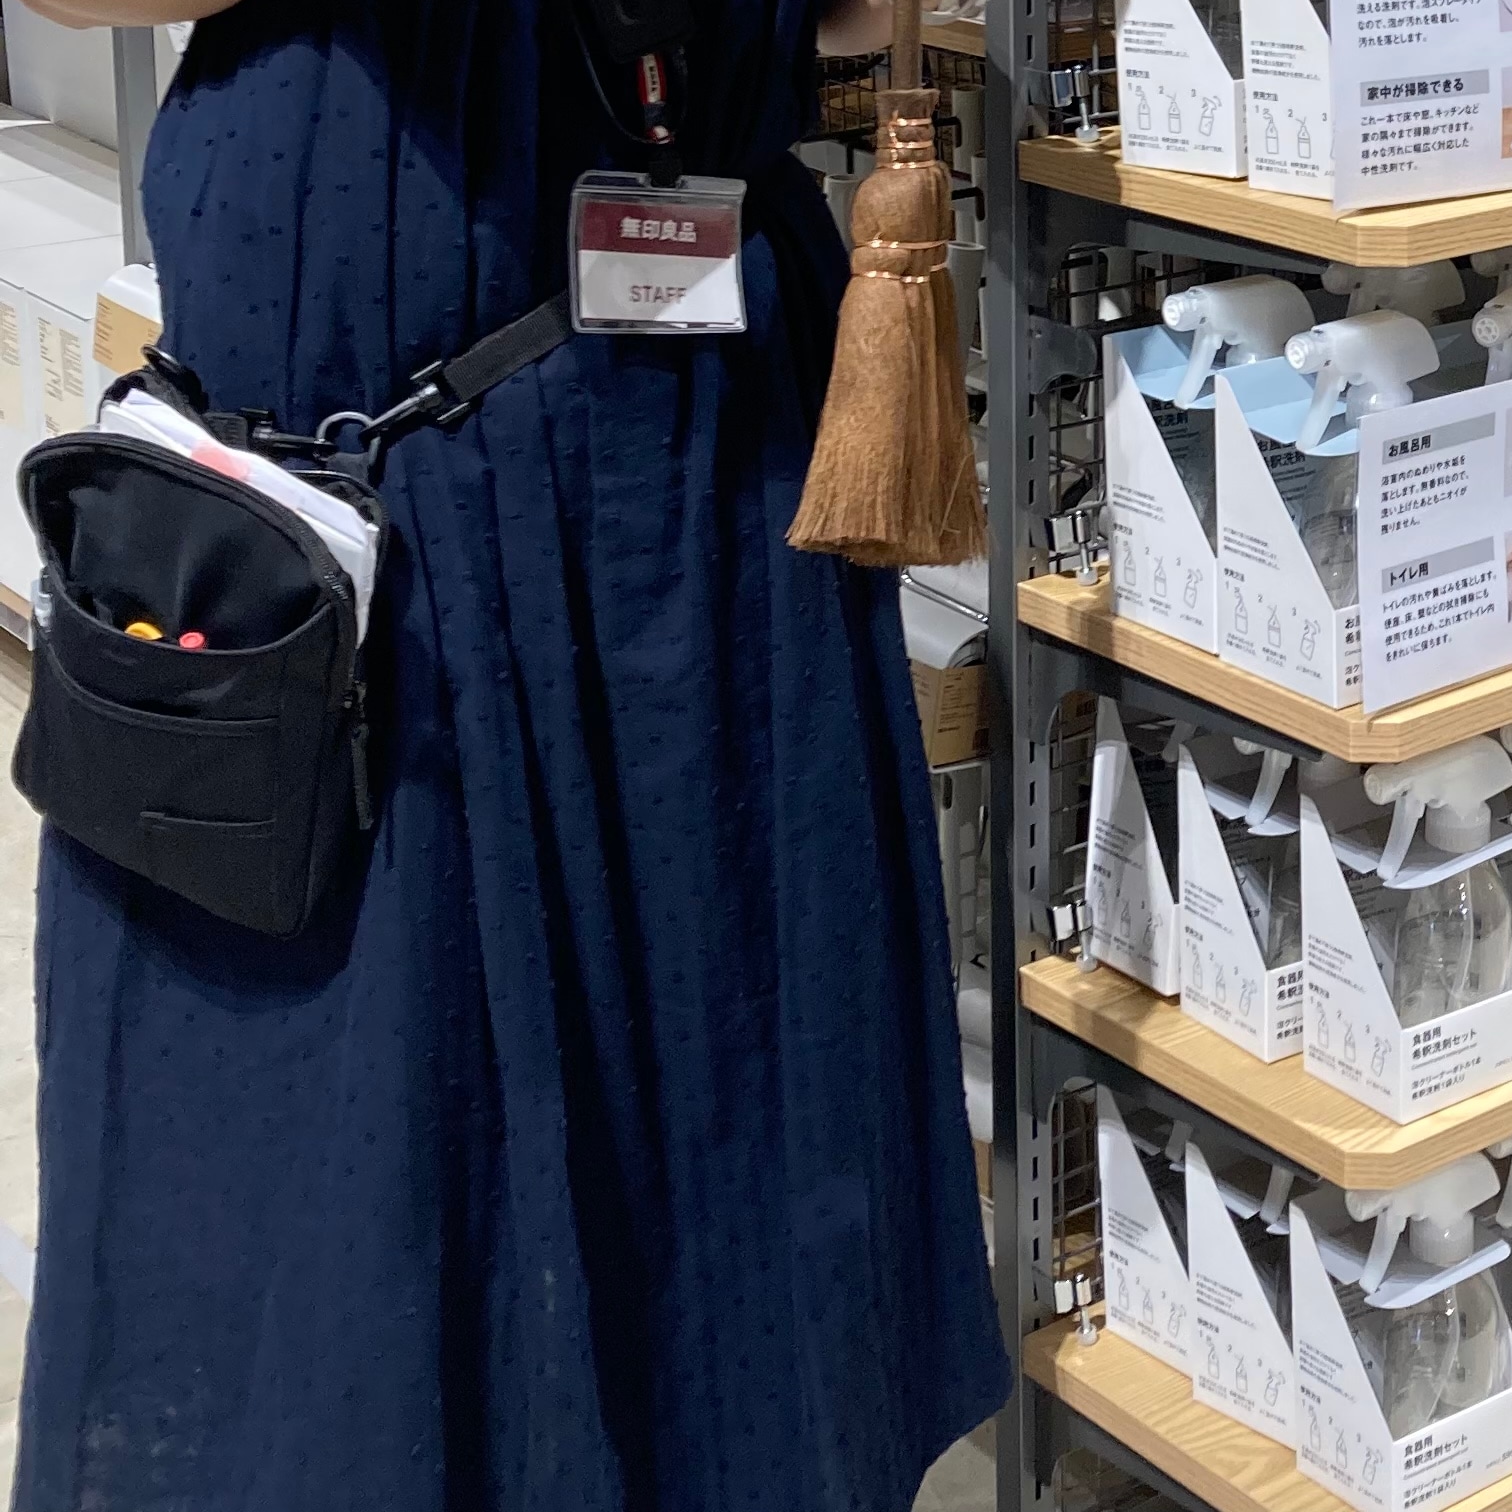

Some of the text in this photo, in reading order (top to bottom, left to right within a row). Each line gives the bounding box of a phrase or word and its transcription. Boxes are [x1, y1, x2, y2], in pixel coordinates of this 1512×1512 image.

[1367, 78, 1463, 100] 家中が掃除できる
[620, 216, 697, 243] 無印良品
[630, 285, 687, 304] STAFF
[1388, 435, 1431, 456] お風呂用
[1391, 562, 1428, 586] トイレ用
[1413, 1026, 1441, 1047] 食器用
